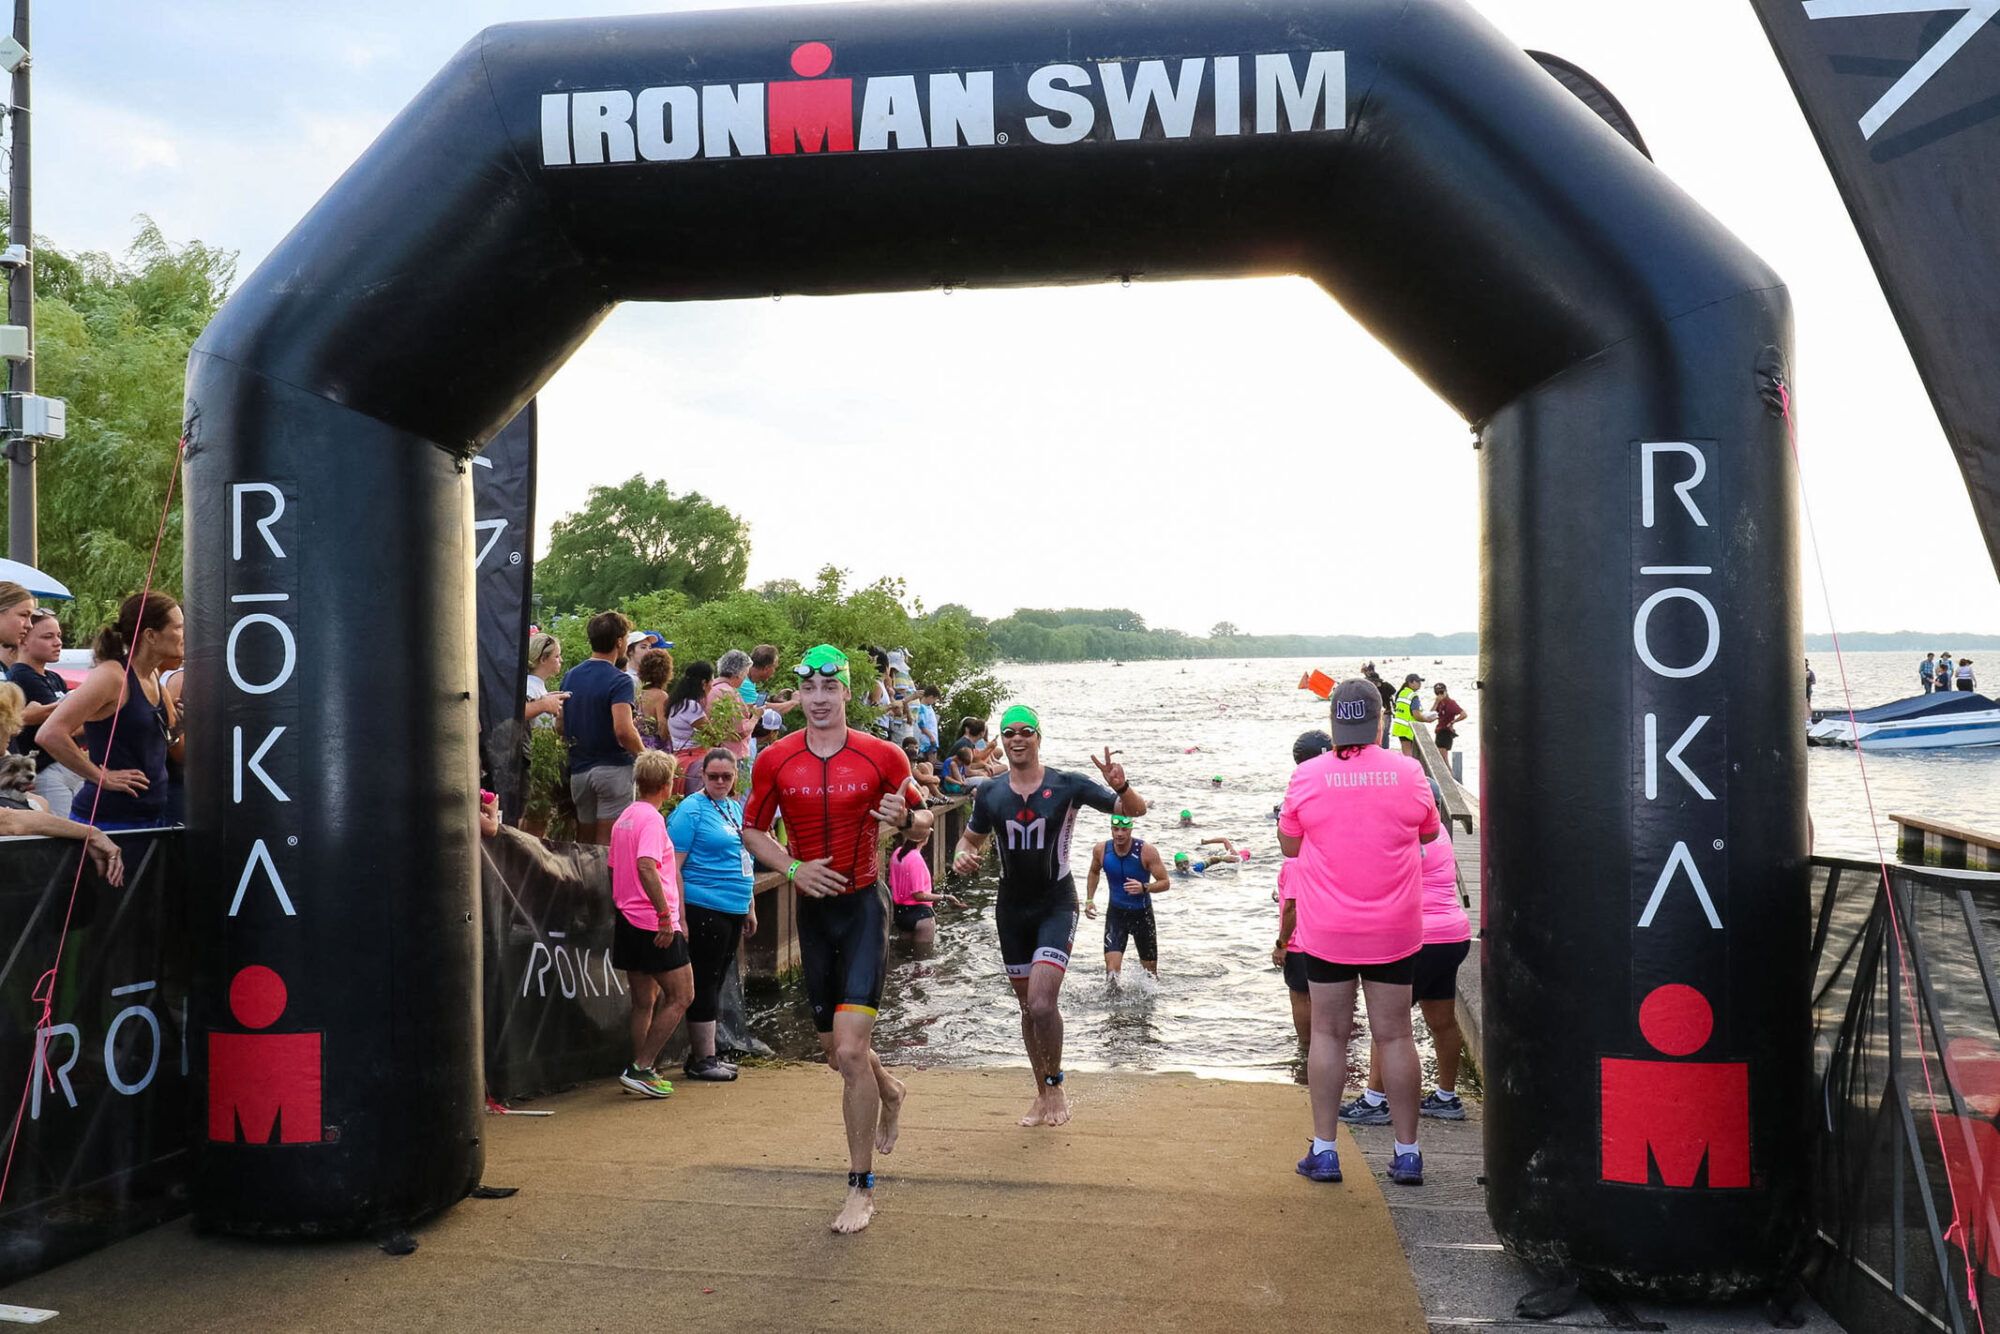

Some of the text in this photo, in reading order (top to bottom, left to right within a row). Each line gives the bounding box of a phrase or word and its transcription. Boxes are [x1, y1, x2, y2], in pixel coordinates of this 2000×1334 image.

[1025, 49, 1347, 146] SWIM
[1336, 700, 1366, 720] NU
[1325, 770, 1399, 788] VOLUNTEER
